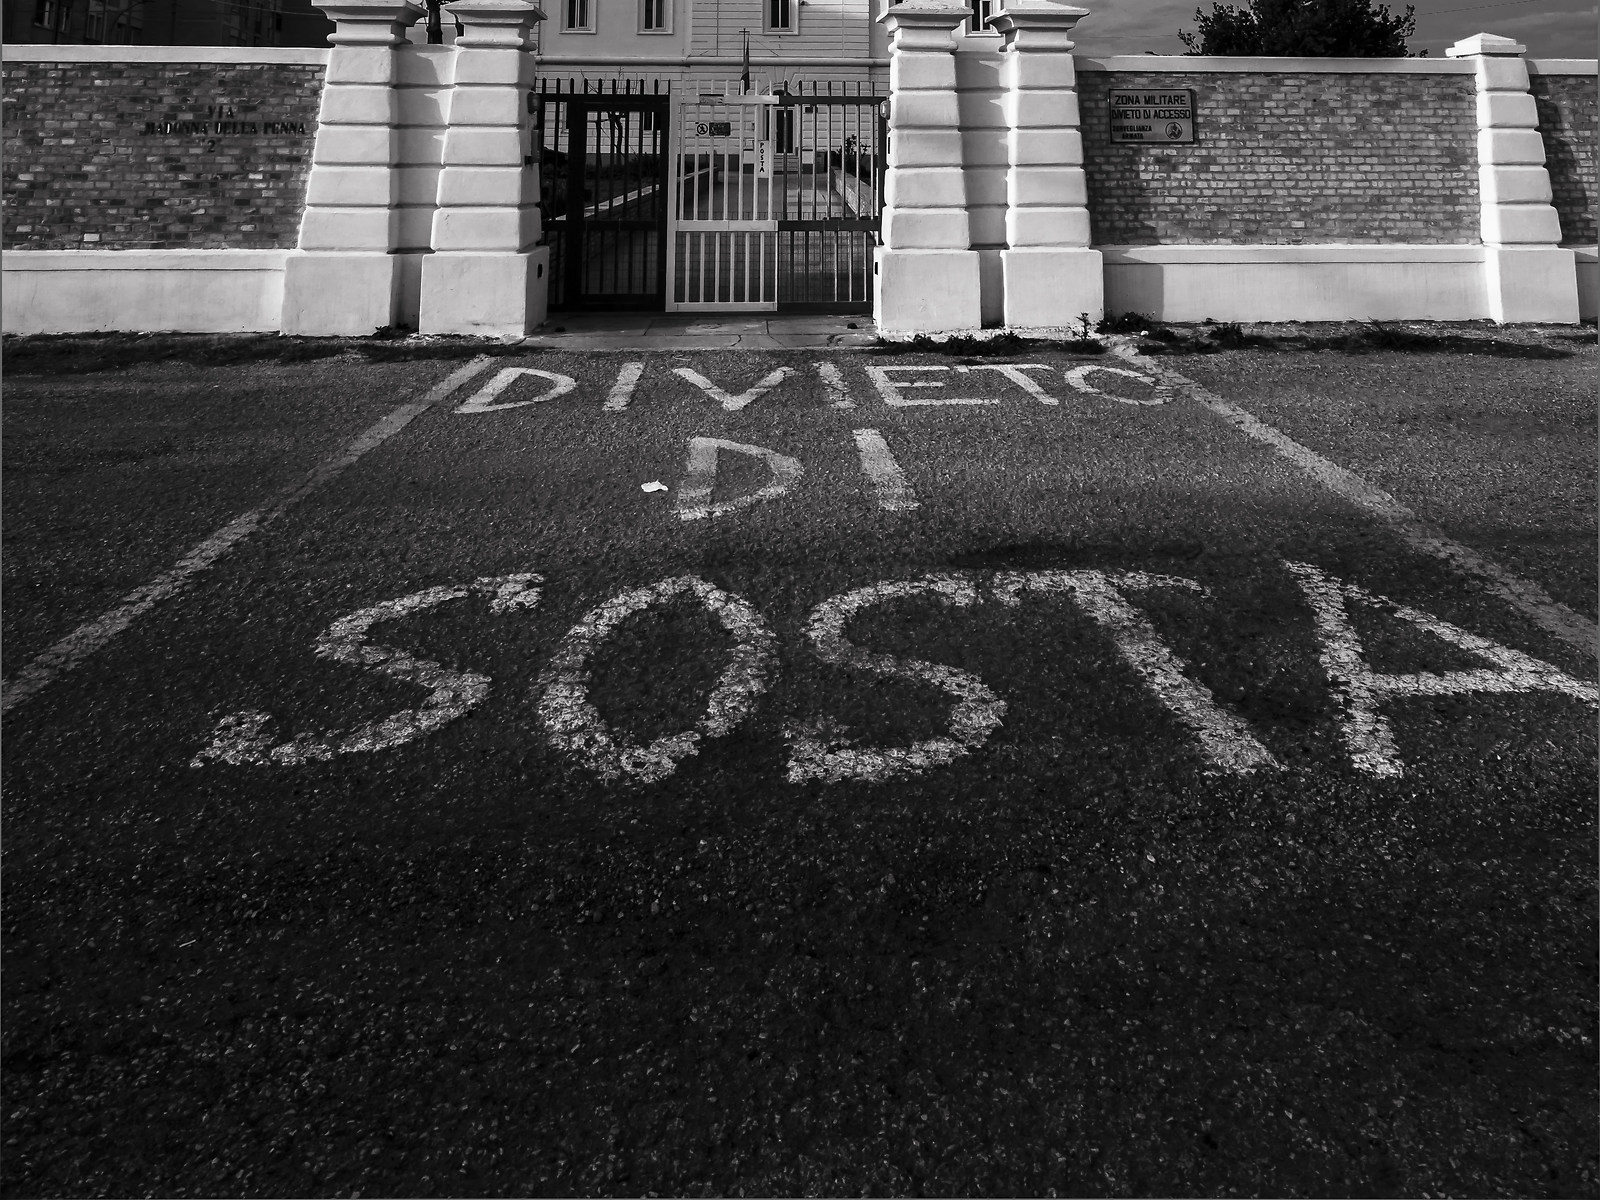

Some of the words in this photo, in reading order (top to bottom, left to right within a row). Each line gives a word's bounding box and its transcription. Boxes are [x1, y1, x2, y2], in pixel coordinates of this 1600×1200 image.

[1115, 95, 1140, 105] ZONA
[1144, 95, 1186, 105] MILITARE
[208, 105, 234, 119] VIA
[1111, 109, 1141, 119] DIVIETO
[1143, 109, 1151, 119] DI
[1153, 109, 1191, 119] ACCESSO
[144, 121, 208, 135] MADONNA
[215, 121, 258, 135] DELLA
[263, 121, 306, 135] PENNA
[207, 140, 216, 153] 2
[453, 361, 1174, 414] DIVIETO
[672, 428, 919, 521] DI
[189, 561, 1599, 785] SOSTA
